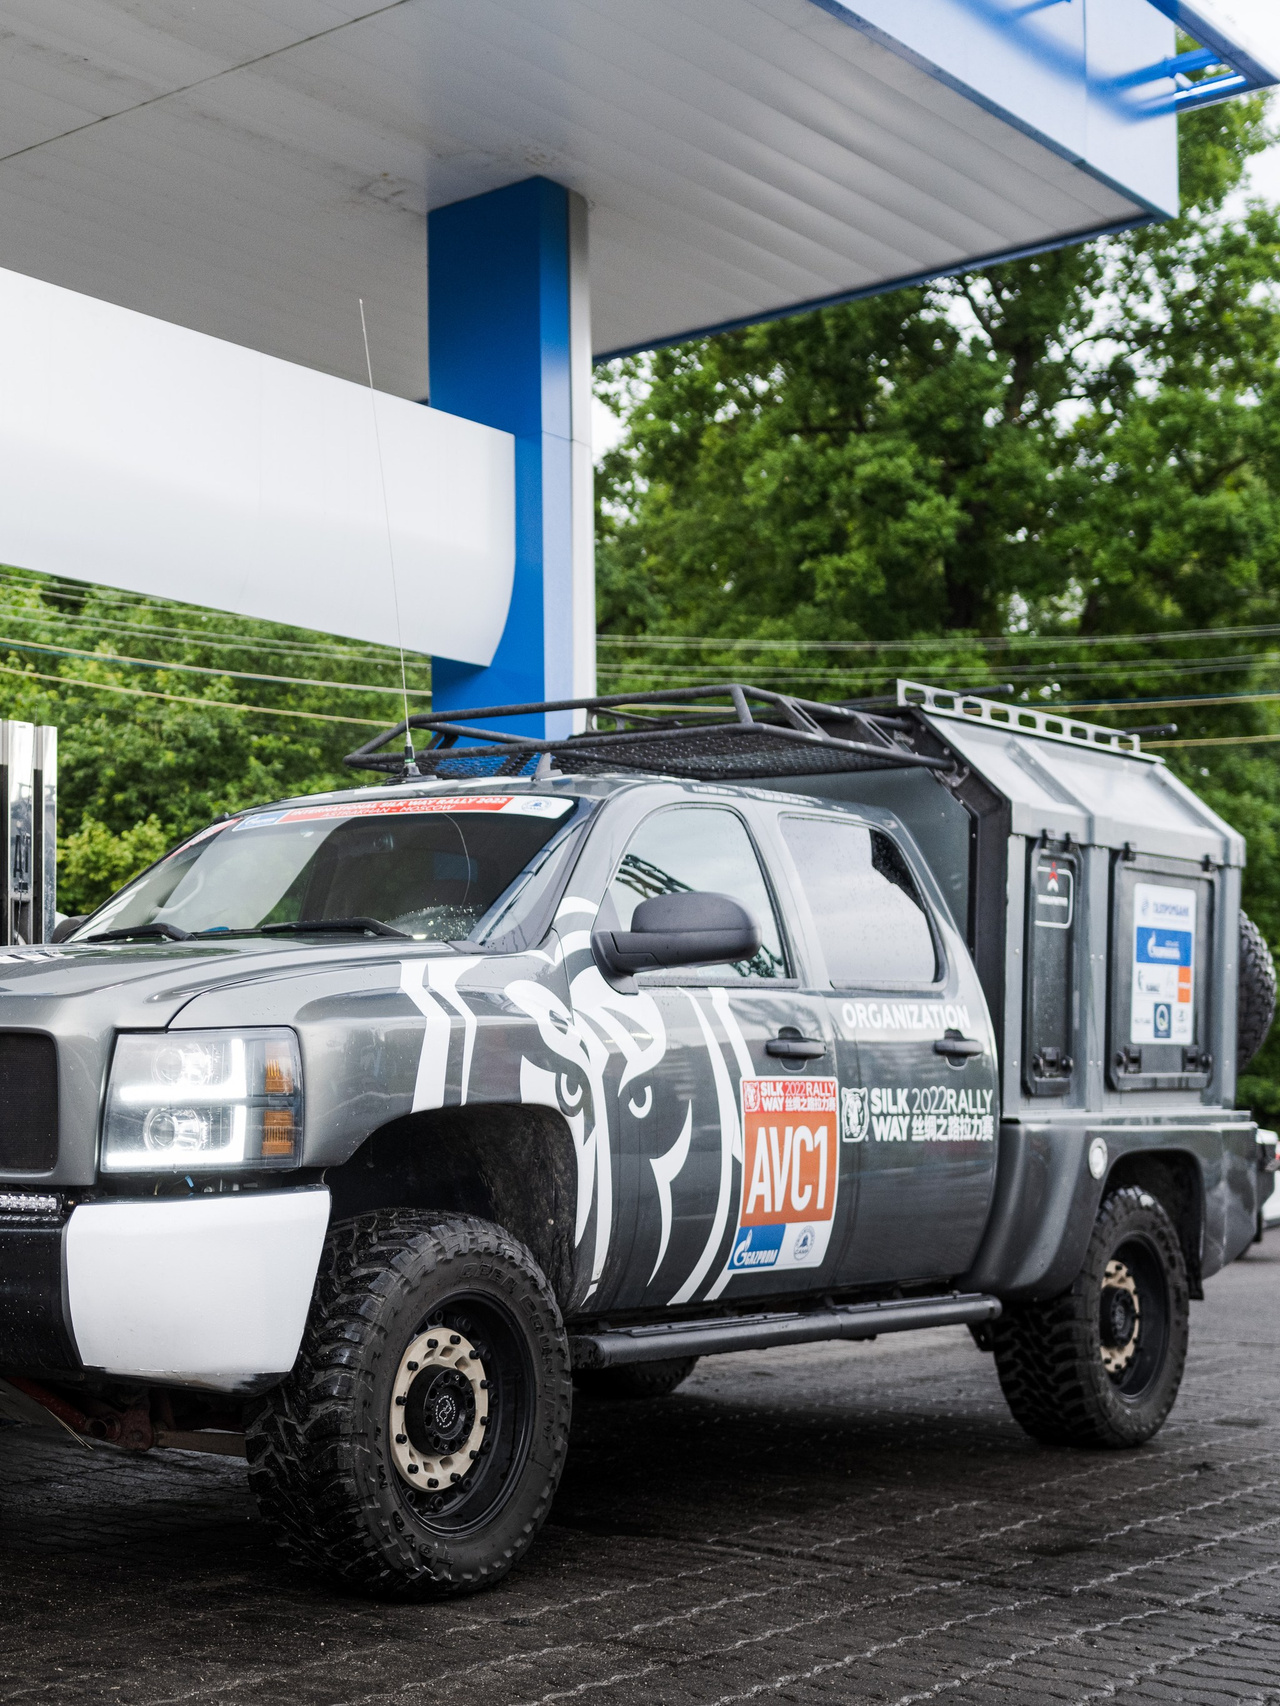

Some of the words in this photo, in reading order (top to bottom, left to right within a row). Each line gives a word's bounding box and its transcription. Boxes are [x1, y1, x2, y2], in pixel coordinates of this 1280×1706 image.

[401, 804, 456, 813] MOSCOW
[434, 797, 475, 805] RALLY
[842, 1003, 970, 1030] ORGANIZATION
[761, 1081, 784, 1097] SILK
[785, 1081, 806, 1098] 2022
[806, 1081, 835, 1097] RALLY
[762, 1097, 785, 1112] WAY
[870, 1087, 911, 1115] SILK
[911, 1086, 947, 1114] 2022
[947, 1087, 994, 1115] RALLY
[872, 1115, 911, 1142] WAY
[745, 1125, 829, 1214] AVC1
[744, 1248, 779, 1266] GAZPROM
